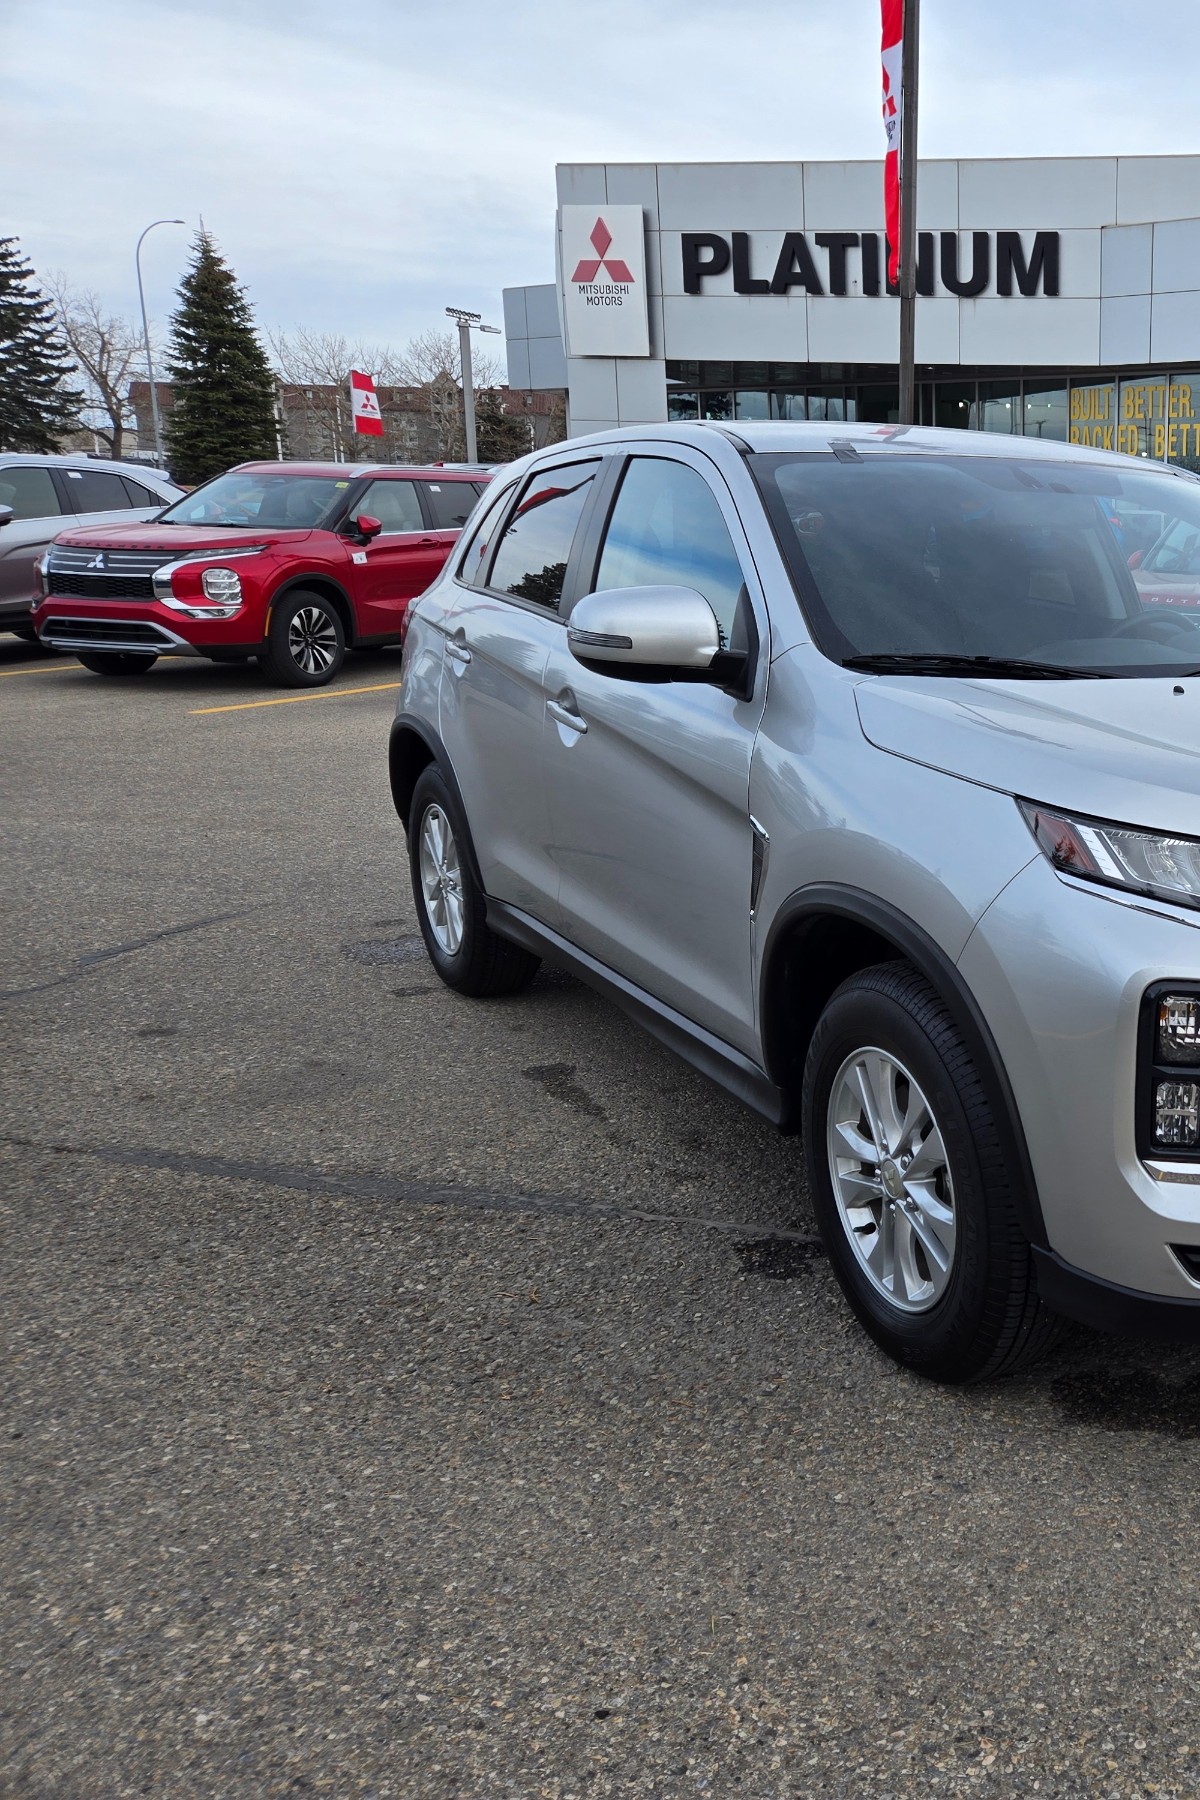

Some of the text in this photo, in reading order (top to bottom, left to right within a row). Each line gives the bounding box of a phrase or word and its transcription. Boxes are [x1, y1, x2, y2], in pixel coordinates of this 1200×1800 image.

[680, 231, 1060, 297] PLATINUM
[578, 284, 630, 295] MITSUBISHI
[586, 296, 623, 306] MOTORS
[1070, 384, 1196, 421] BUILT BETTER.
